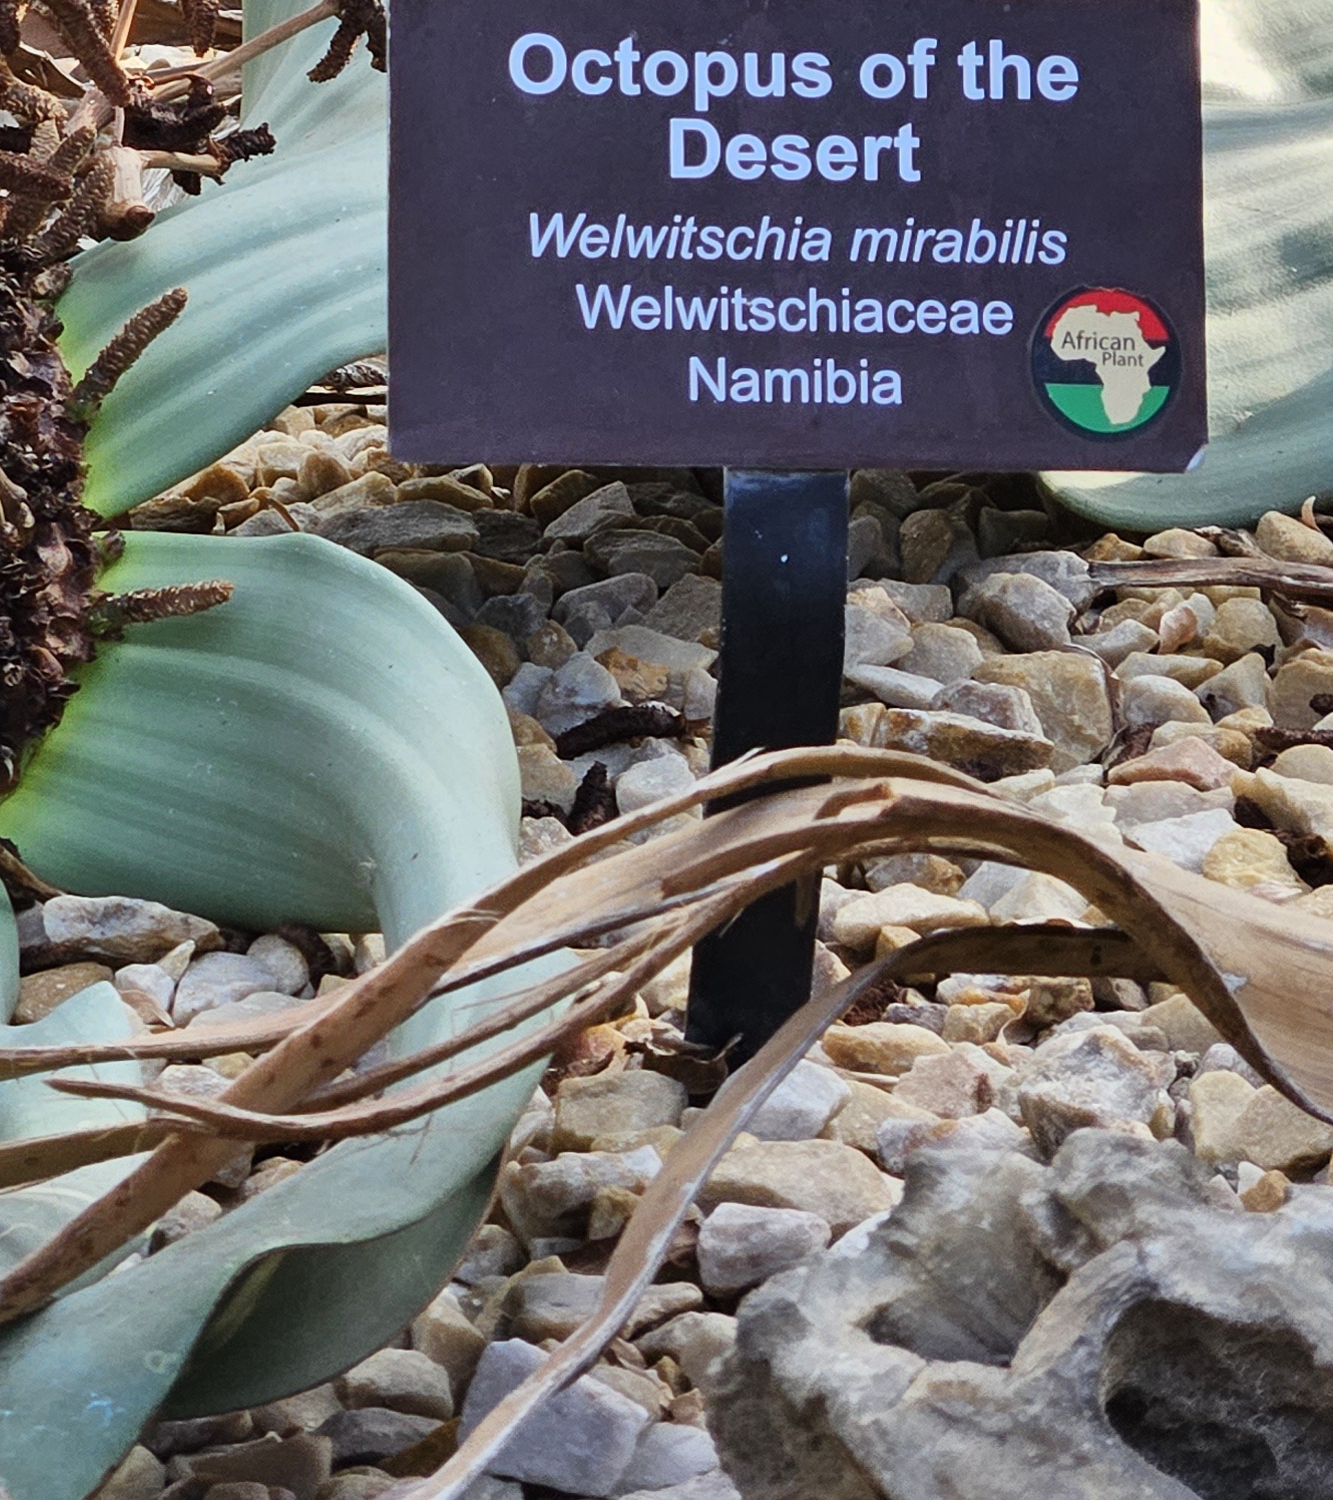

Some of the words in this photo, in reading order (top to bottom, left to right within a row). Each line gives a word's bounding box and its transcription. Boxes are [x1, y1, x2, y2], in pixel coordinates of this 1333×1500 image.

[508, 32, 833, 111] Octopus
[859, 37, 938, 99] of
[957, 39, 1079, 101] the
[669, 117, 921, 182] Desert
[529, 212, 832, 263] Welwitschia
[849, 217, 1068, 265] mirabilis
[575, 283, 1014, 336] Welwitschiaceae
[1061, 330, 1136, 351] African
[1102, 351, 1144, 367] Plant
[688, 356, 903, 405] Namibia
